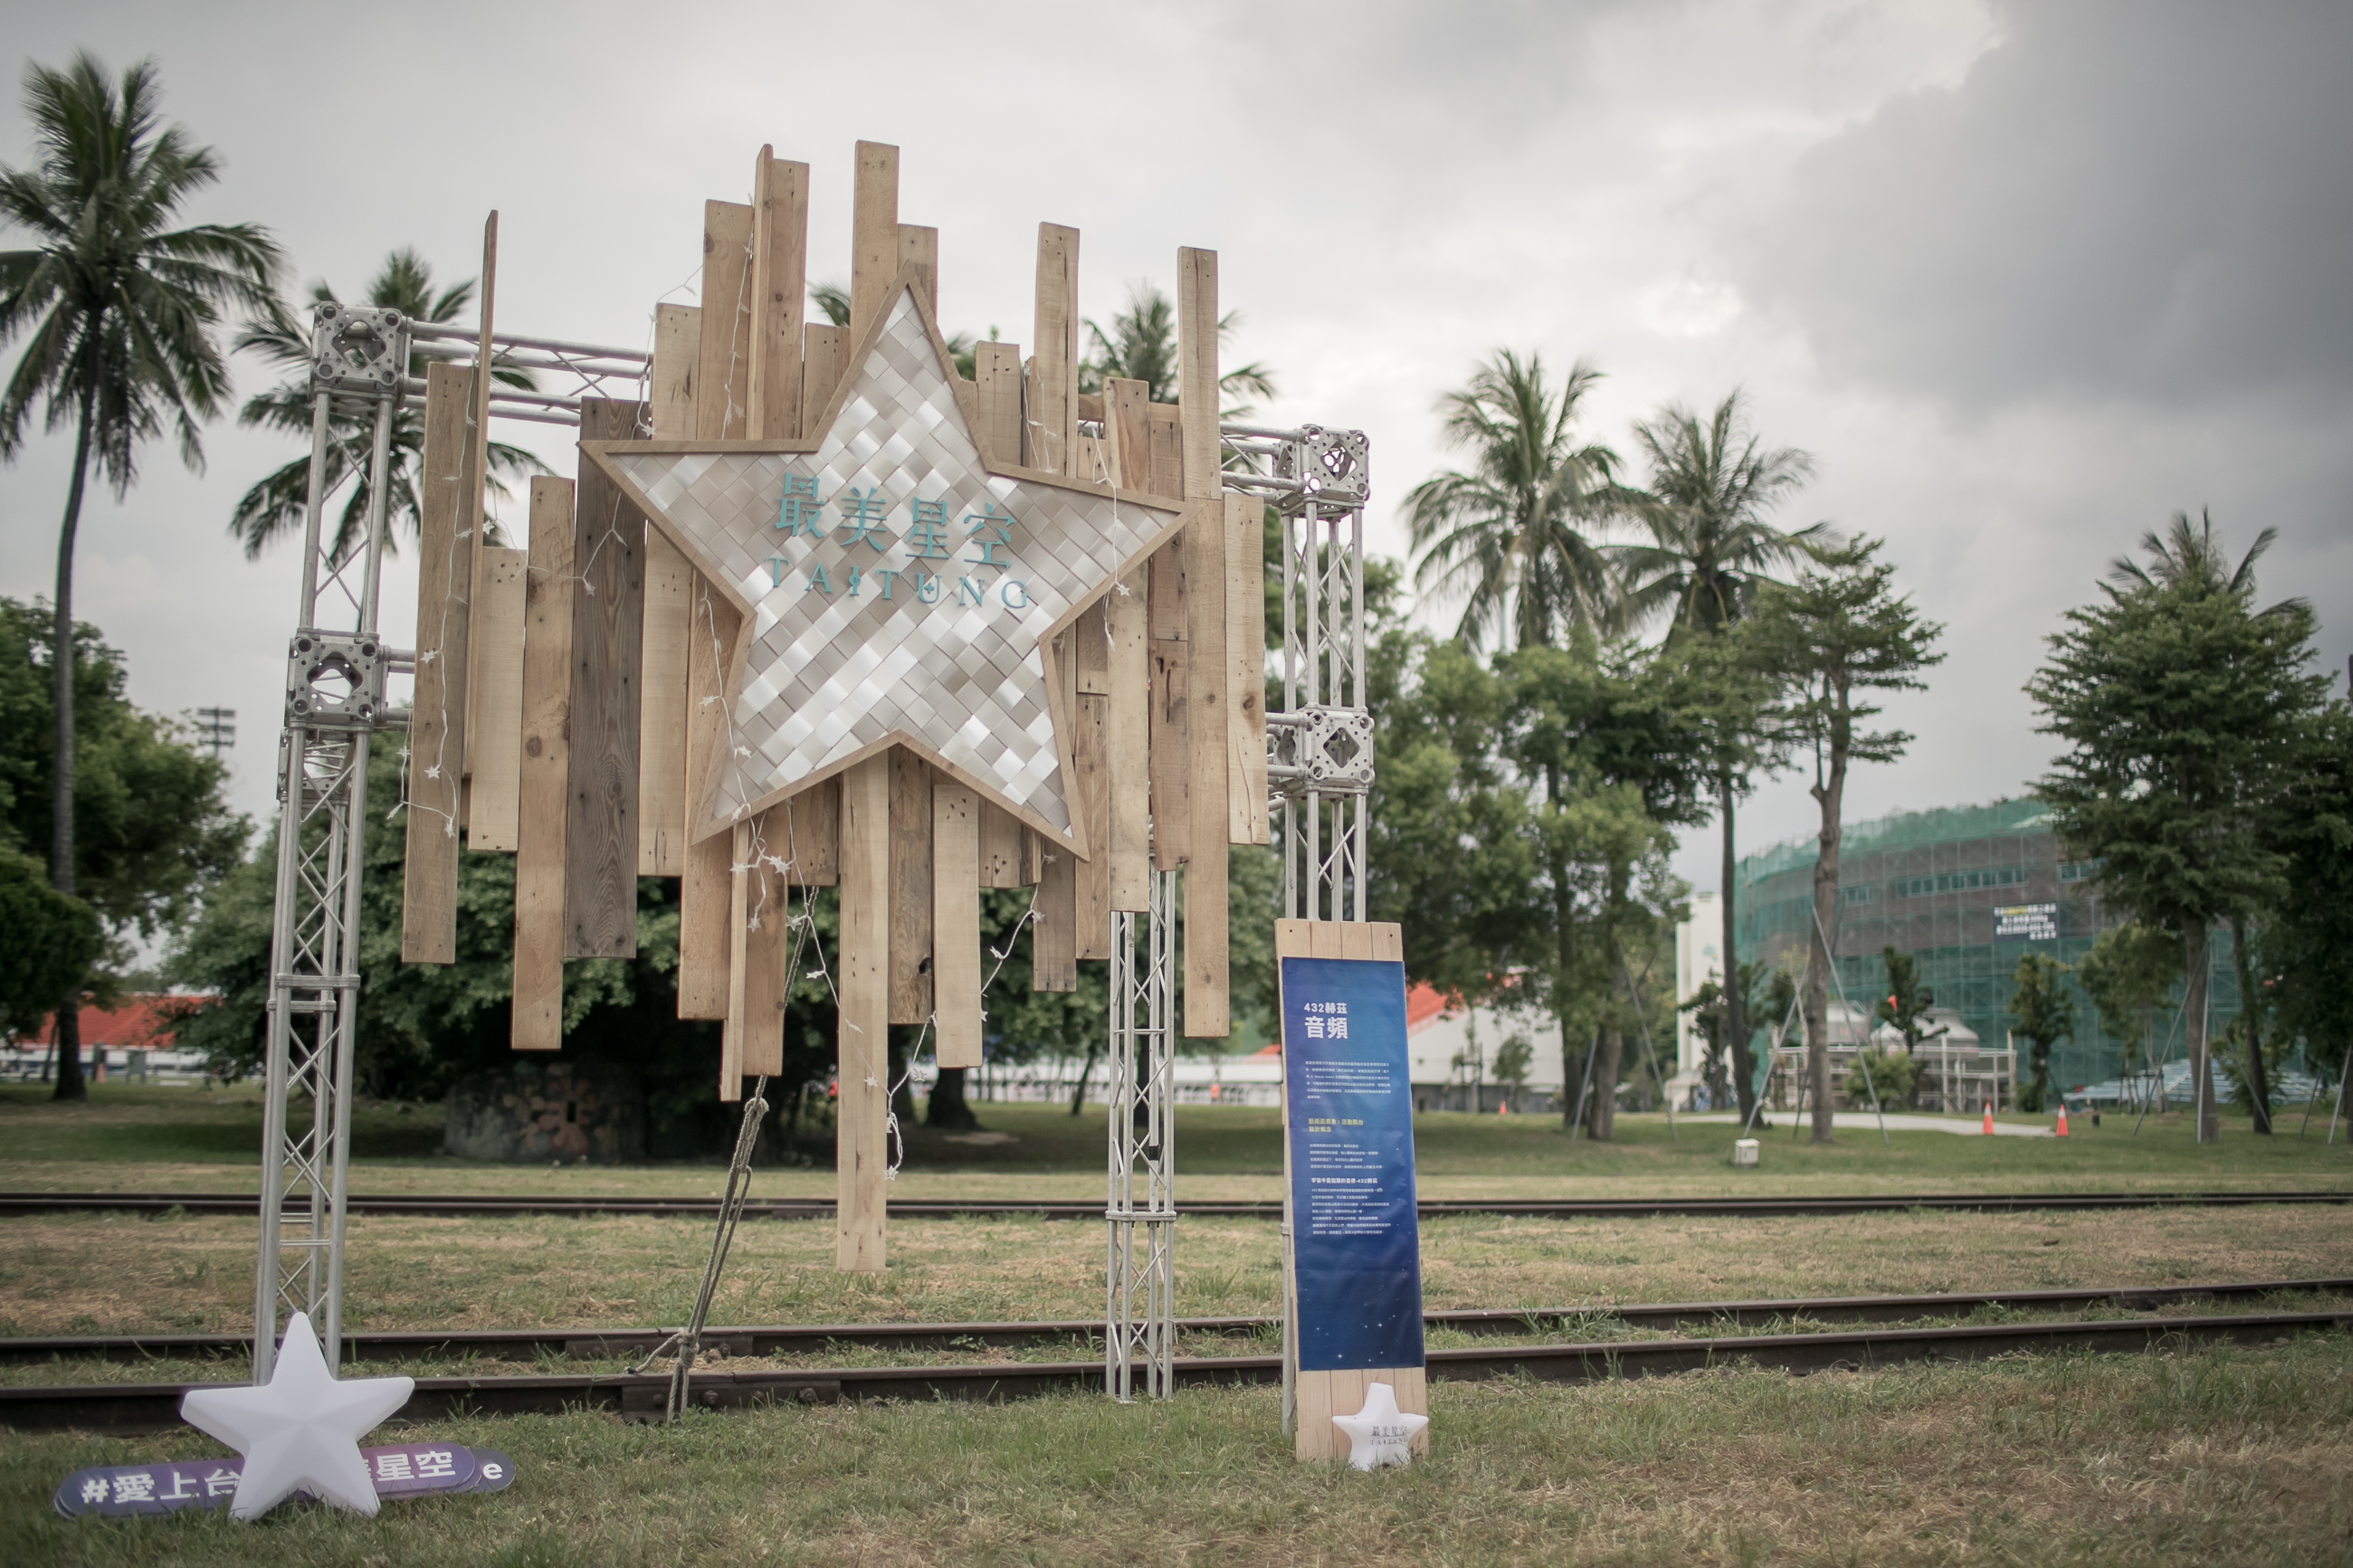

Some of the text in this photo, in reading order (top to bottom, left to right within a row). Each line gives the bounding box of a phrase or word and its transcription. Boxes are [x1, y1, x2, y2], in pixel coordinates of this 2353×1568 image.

[775, 472, 1015, 568] 最美星空
[765, 556, 1029, 609] TAITUNG
[1304, 1015, 1348, 1040] 音頻
